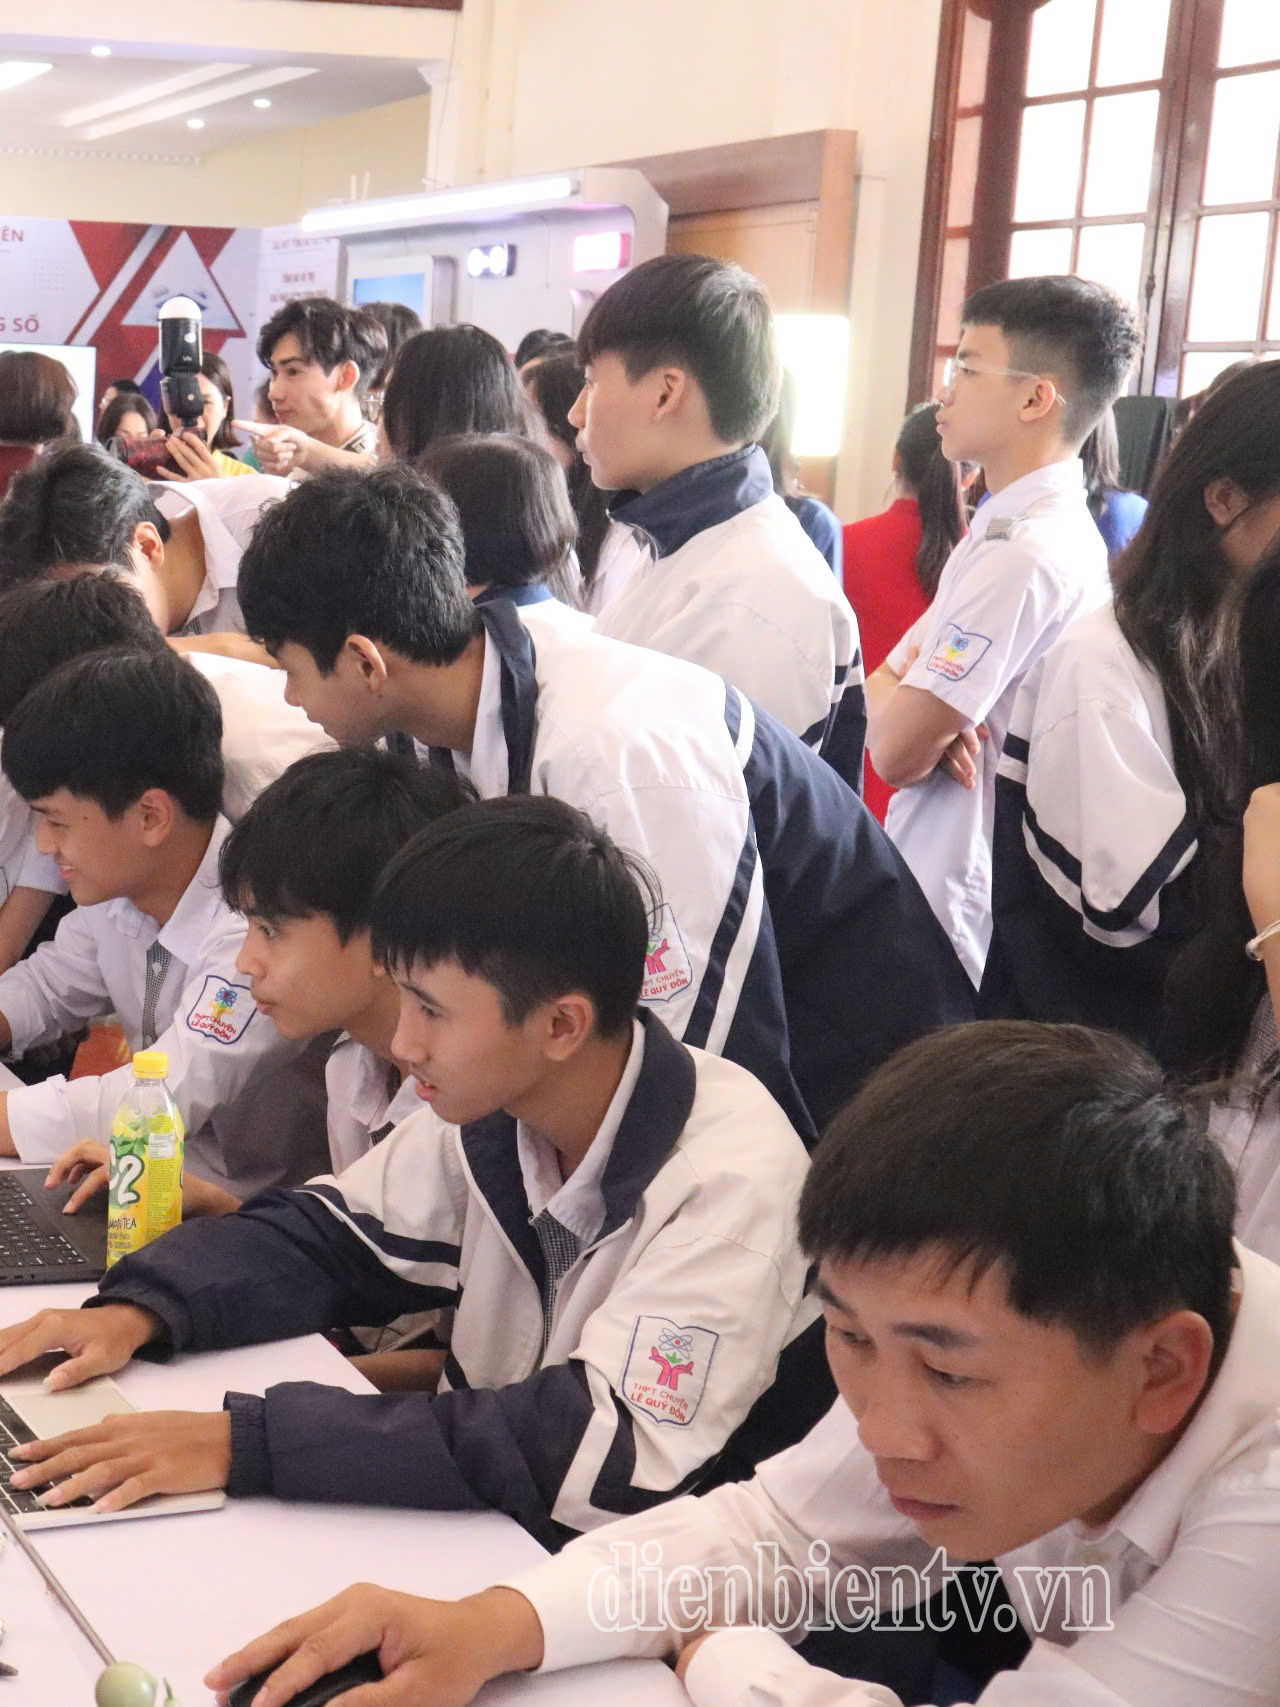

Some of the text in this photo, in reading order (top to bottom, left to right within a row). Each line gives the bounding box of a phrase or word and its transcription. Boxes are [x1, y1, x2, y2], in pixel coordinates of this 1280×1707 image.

[13, 312, 40, 333] SỐ
[670, 977, 688, 990] ĐÔN
[122, 1216, 137, 1230] TEA
[630, 1392, 644, 1403] LÊ
[669, 1405, 686, 1422] ĐÔN
[633, 1383, 688, 1411] THPT CHUYÊN
